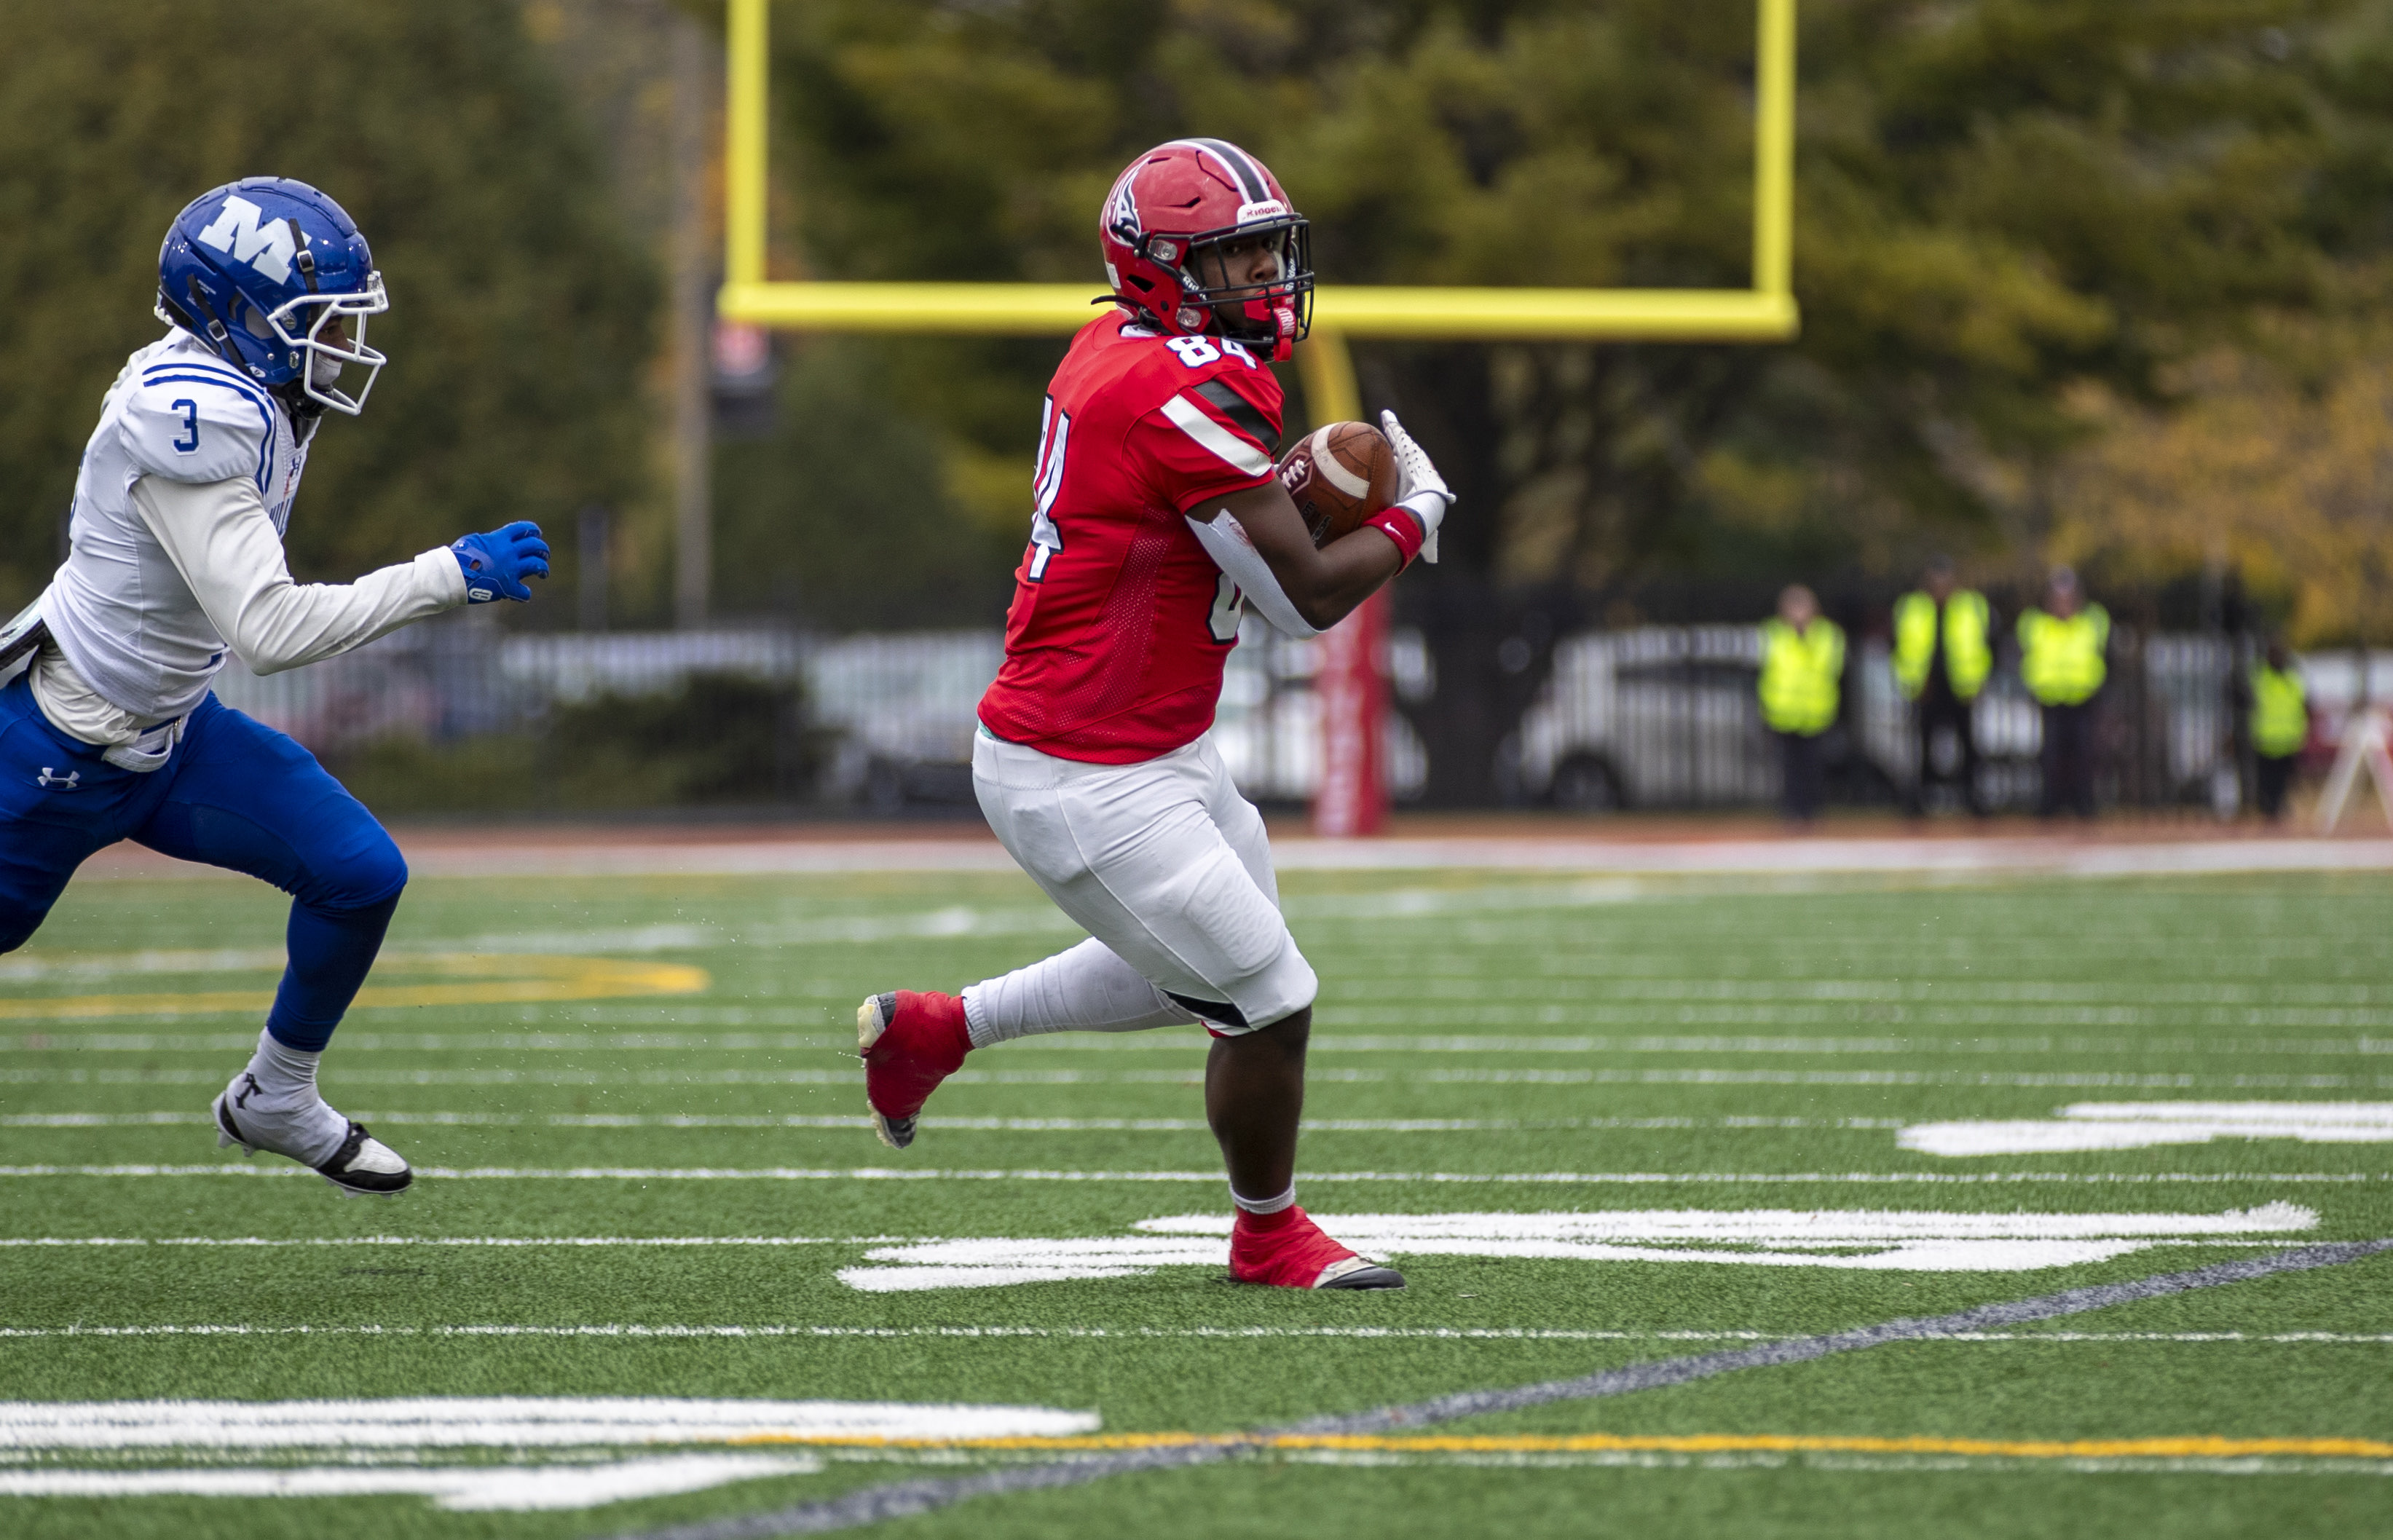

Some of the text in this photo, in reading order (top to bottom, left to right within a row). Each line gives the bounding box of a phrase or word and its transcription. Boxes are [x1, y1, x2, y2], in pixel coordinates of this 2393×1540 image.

[197, 194, 312, 285] M
[1164, 334, 1258, 370] 84
[171, 398, 200, 453] 3
[1028, 392, 1071, 583] 4
